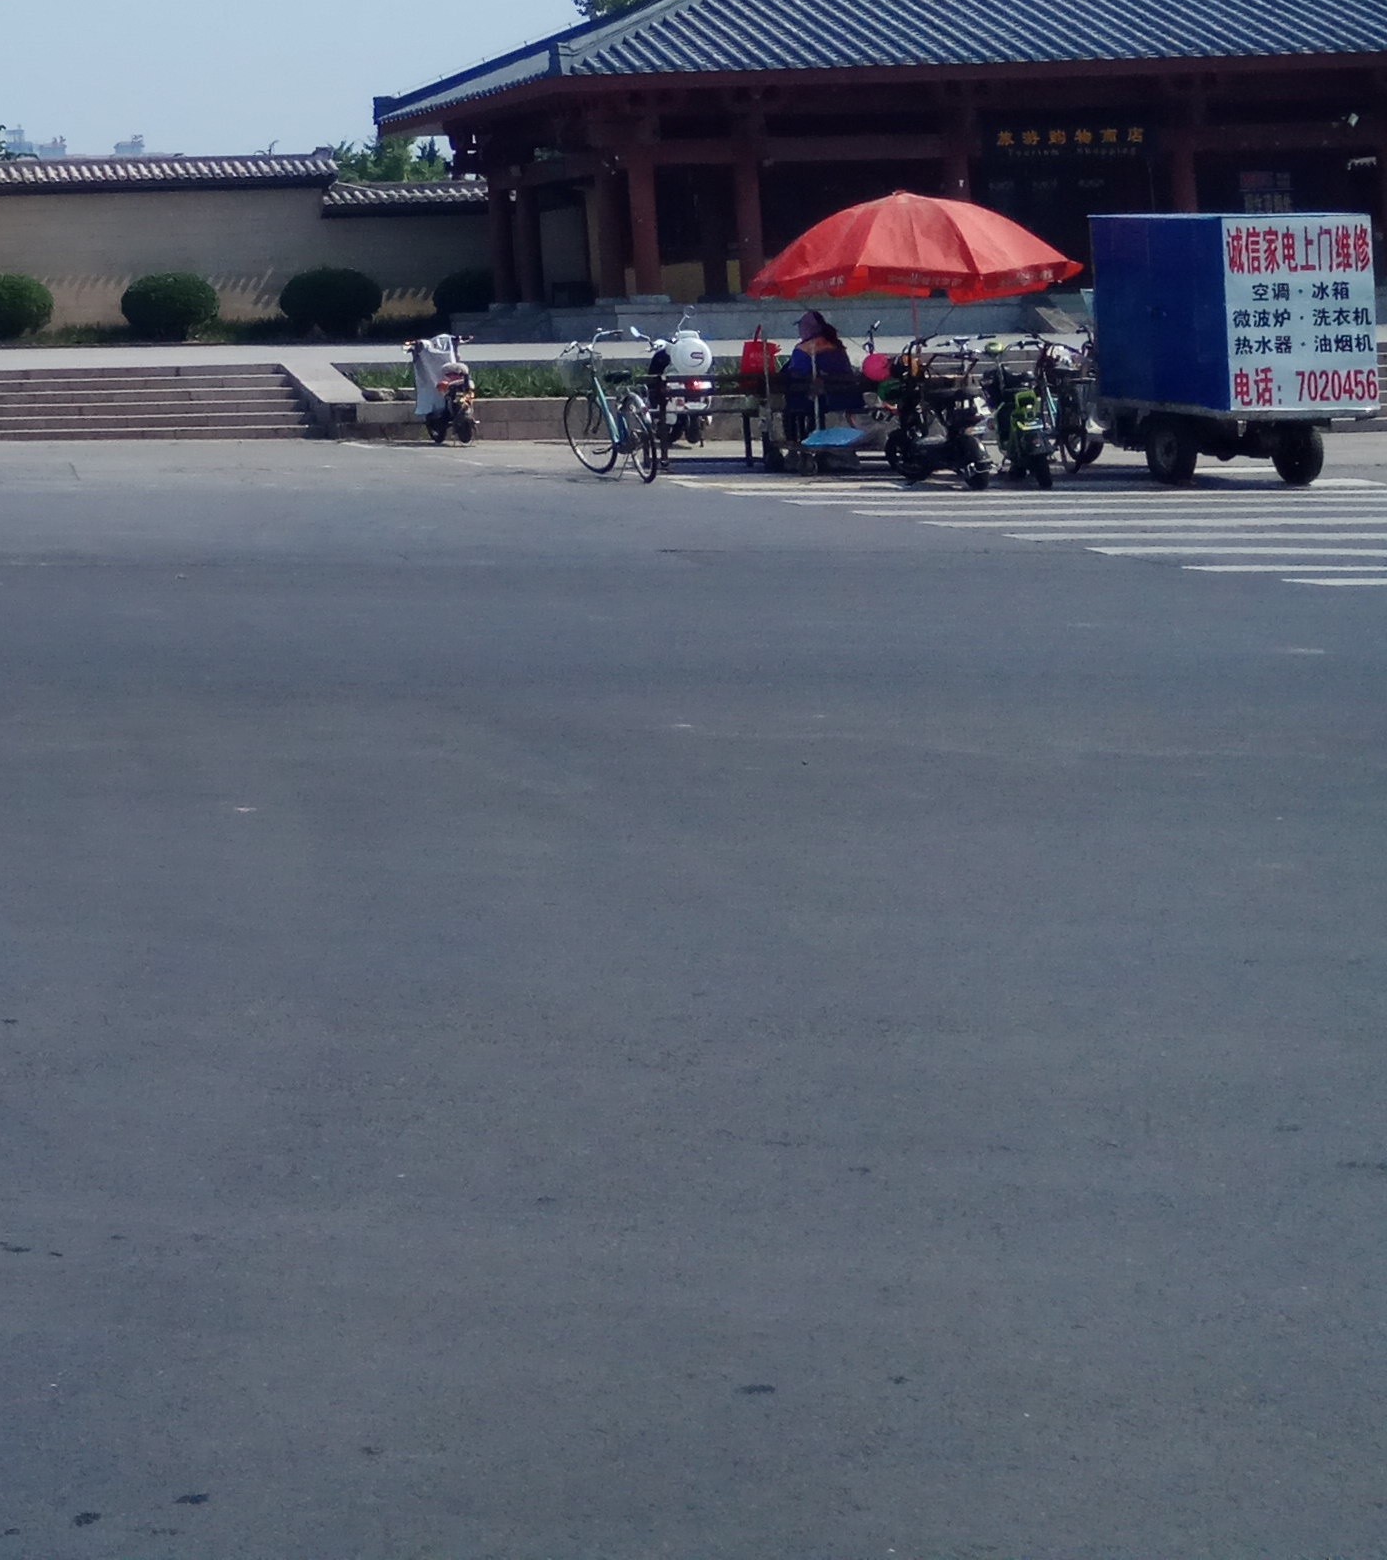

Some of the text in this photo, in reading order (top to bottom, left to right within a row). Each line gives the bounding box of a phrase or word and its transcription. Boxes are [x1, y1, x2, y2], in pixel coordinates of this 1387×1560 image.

[1227, 224, 1370, 274] 诚信家电上门维修
